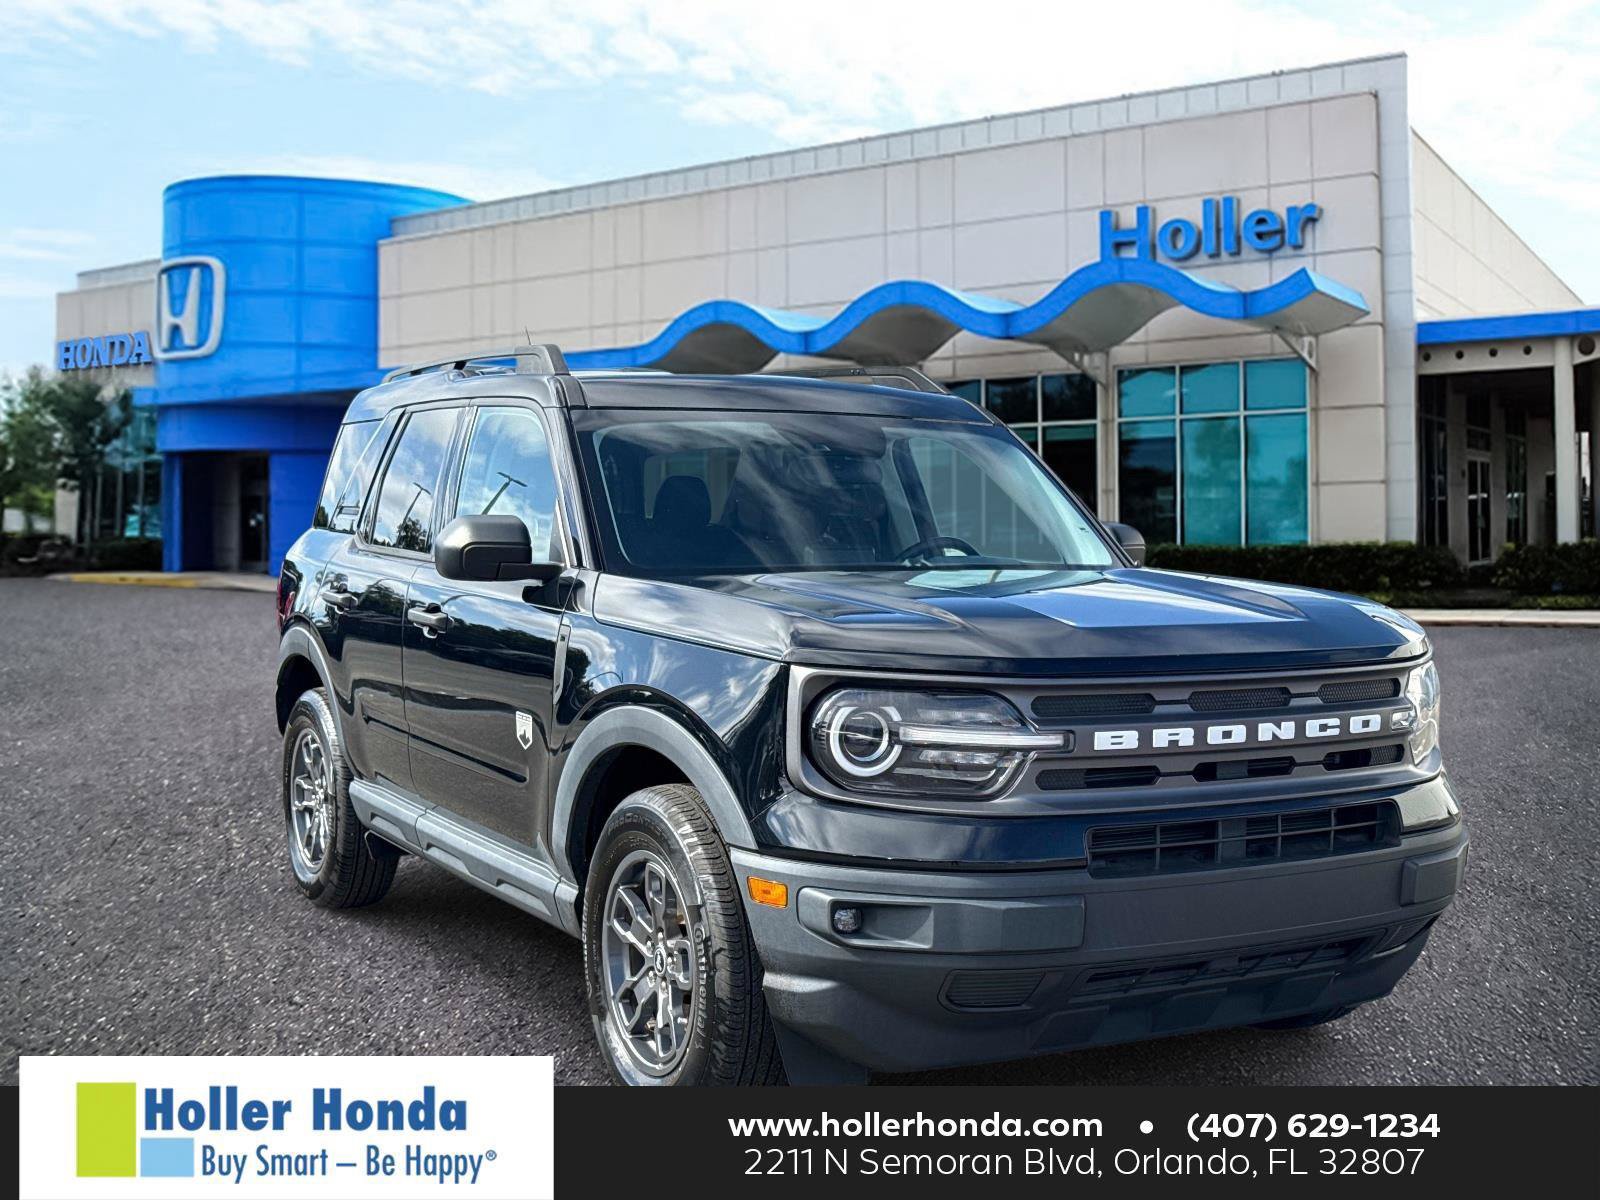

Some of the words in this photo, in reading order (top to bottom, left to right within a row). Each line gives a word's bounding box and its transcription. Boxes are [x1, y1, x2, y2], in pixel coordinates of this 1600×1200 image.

[1099, 196, 1321, 262] Holler
[58, 331, 152, 371] HONDA
[1094, 713, 1381, 751] BRONCO
